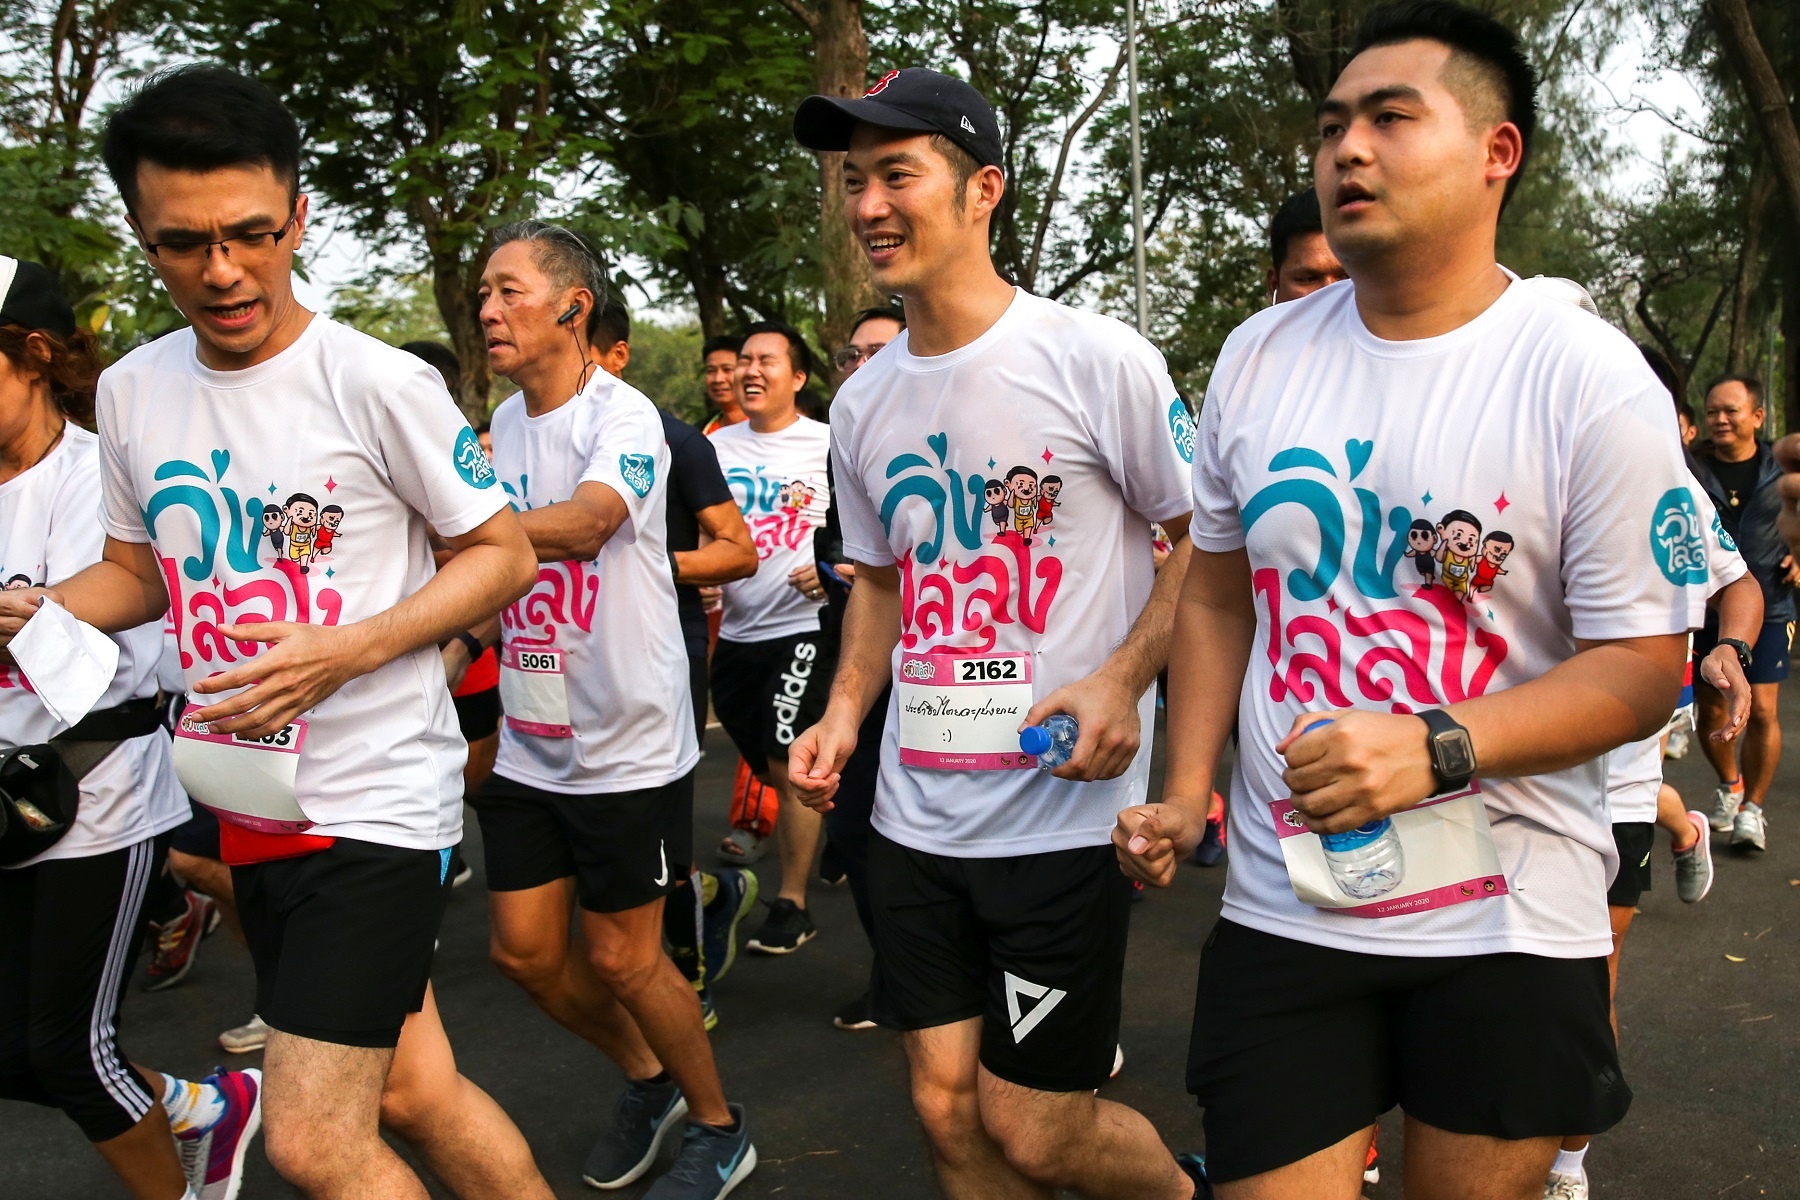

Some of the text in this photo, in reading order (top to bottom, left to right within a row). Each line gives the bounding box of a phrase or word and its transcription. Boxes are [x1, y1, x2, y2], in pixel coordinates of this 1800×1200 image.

[139, 449, 265, 582] วิ่ง
[879, 431, 986, 565] วิ่ง
[1239, 438, 1412, 602] วิ่ง
[897, 530, 1063, 654] ไล่ลุง
[522, 653, 556, 670] 5061
[773, 642, 818, 746] adidas
[962, 660, 1017, 680] 2162
[1387, 901, 1412, 911] JANUARY
[1414, 897, 1429, 906] 2020
